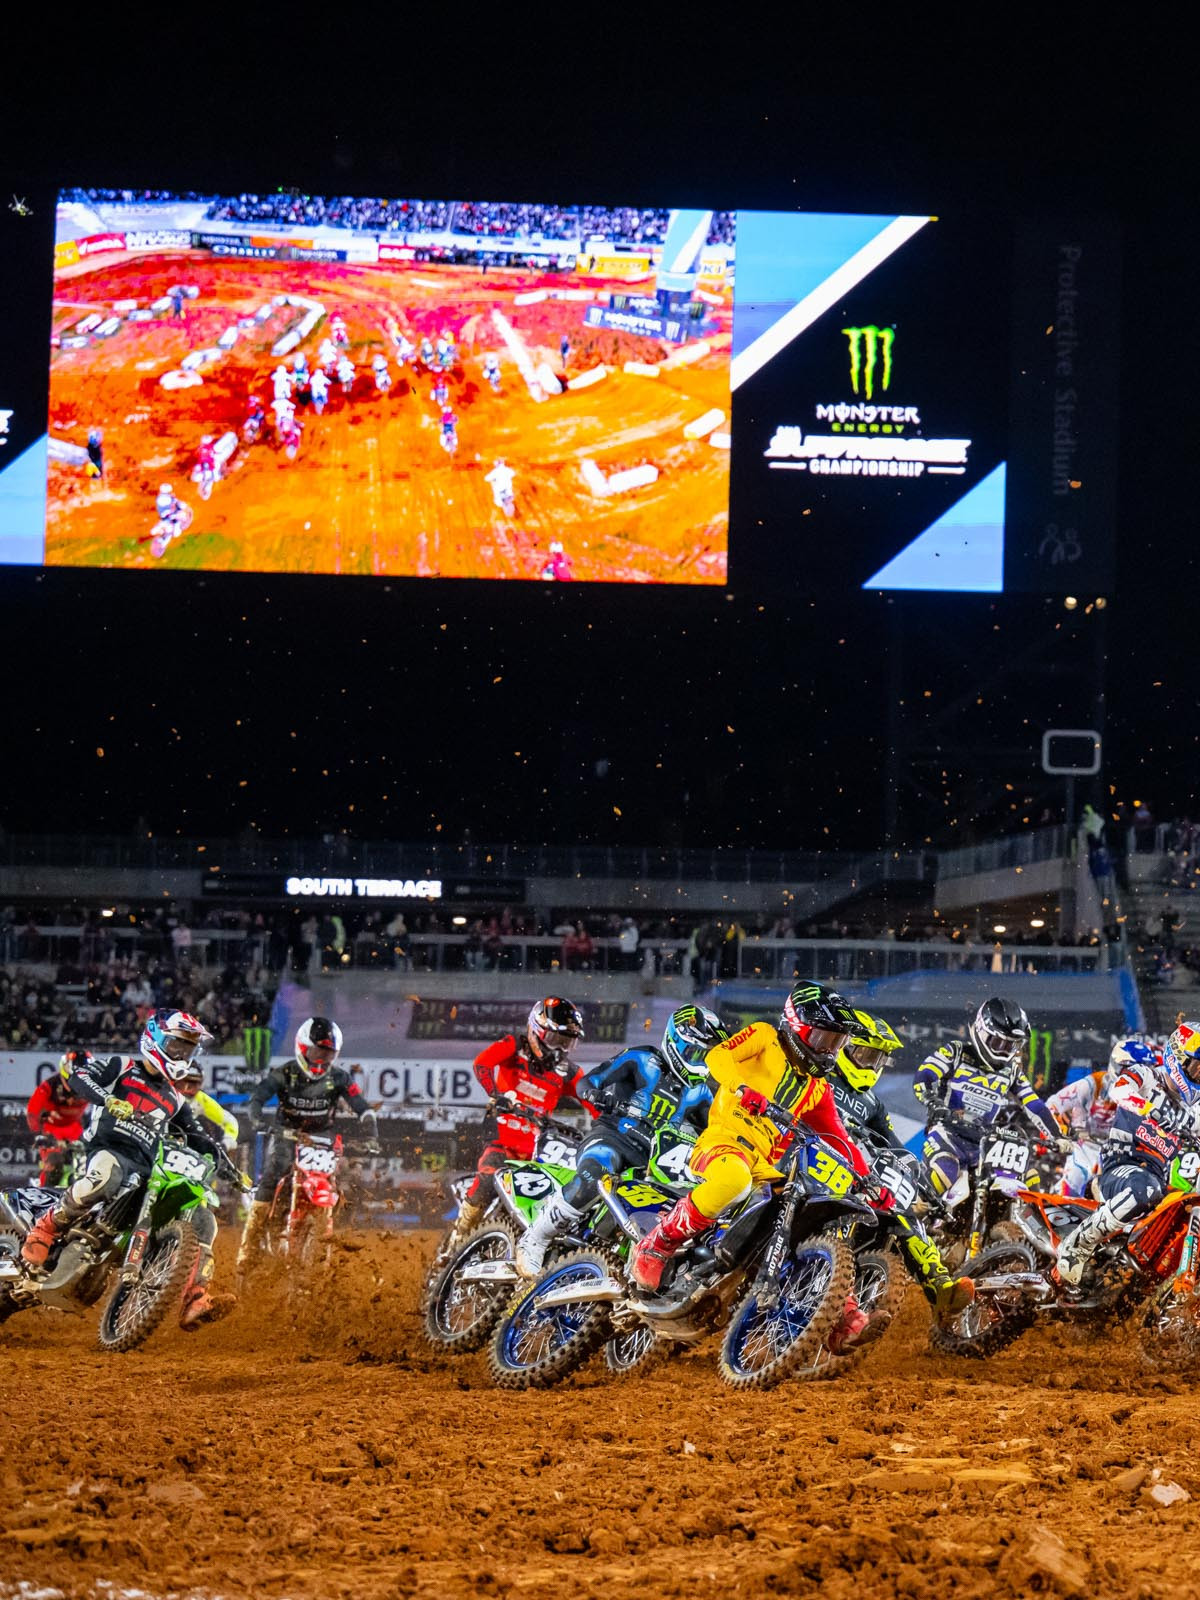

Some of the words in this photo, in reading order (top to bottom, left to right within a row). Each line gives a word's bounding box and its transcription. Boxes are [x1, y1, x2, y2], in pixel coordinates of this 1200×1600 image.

[816, 402, 921, 424] MONSTER
[831, 423, 905, 434] ENERGY
[809, 459, 925, 477] CHAMPIONSHIP
[286, 877, 352, 895] SOUTH
[354, 878, 442, 897] TERRACE
[379, 1069, 471, 1099] CLUB
[960, 1083, 999, 1101] MOTO
[984, 1140, 1030, 1174] 483
[513, 1171, 551, 1197] 43
[808, 1150, 855, 1196] 38
[616, 1183, 669, 1208] 38
[877, 1167, 917, 1210] 33
[768, 1235, 785, 1278] DUNLOP
